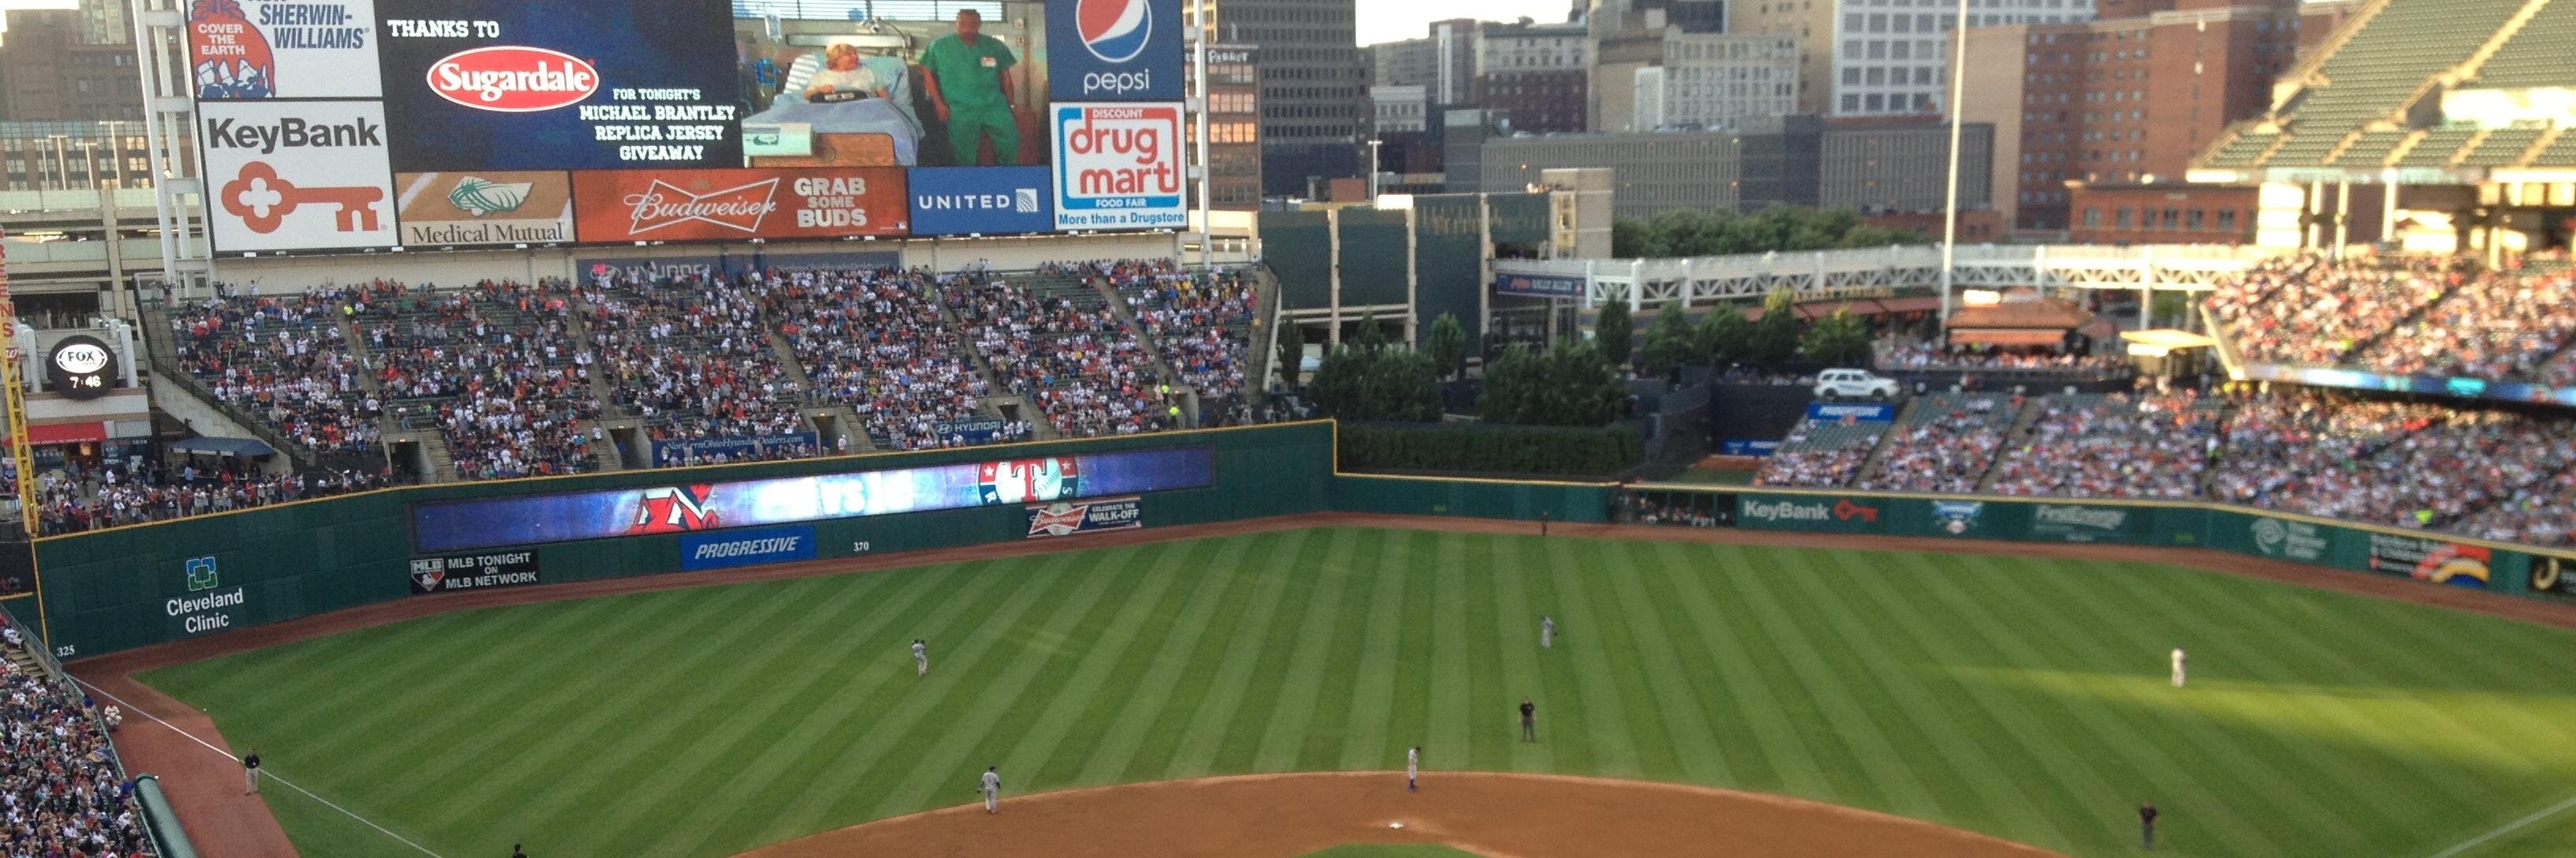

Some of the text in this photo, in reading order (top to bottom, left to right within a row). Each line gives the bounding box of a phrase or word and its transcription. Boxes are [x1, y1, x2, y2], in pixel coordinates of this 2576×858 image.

[259, 4, 353, 25] SHERWIN-
[197, 24, 244, 34] COVER
[387, 20, 500, 38] THANKS TO
[208, 34, 235, 45] THE
[273, 28, 365, 49] WILLIAMS
[201, 45, 245, 55] EARTH
[438, 61, 590, 102] Sugardale
[1084, 69, 1150, 95] pepsi
[612, 88, 701, 100] FOR TONIGHT'S
[579, 105, 736, 121] MICHAEL BRANTLEY
[1092, 108, 1144, 118] DISCOUNT
[208, 117, 381, 155] KeyBank
[595, 126, 724, 141] REPLICA JERSEY
[1069, 113, 1159, 165] drug
[620, 145, 704, 161] GIVEAWAY
[1080, 161, 1180, 194] mart
[793, 177, 867, 197] GRAB
[623, 193, 777, 221] Budweiser
[807, 196, 855, 208] SOME
[919, 195, 1011, 209] UNITED
[1095, 198, 1147, 208] FOOD FAIR
[797, 208, 867, 228] BUDS
[1058, 213, 1087, 224] More
[1091, 213, 1116, 224] than
[1130, 212, 1185, 224] Drugstore
[411, 222, 564, 244] Medical Mutual
[67, 350, 95, 362] FOX
[69, 375, 102, 388] 7:46
[954, 421, 1002, 432] HYUNDAI
[1088, 508, 1140, 523] WALK-OFF
[1744, 500, 1830, 521] KeyBank
[695, 535, 799, 560] PROGRESSIVE
[853, 541, 869, 552] 370
[413, 560, 442, 571] MLB
[448, 553, 531, 569] MLB TONIGHT
[484, 566, 498, 575] ON
[445, 571, 537, 589] MLB NETWORK
[167, 588, 244, 616] Cleveland
[185, 612, 230, 634] Clinic
[57, 645, 75, 658] 325
